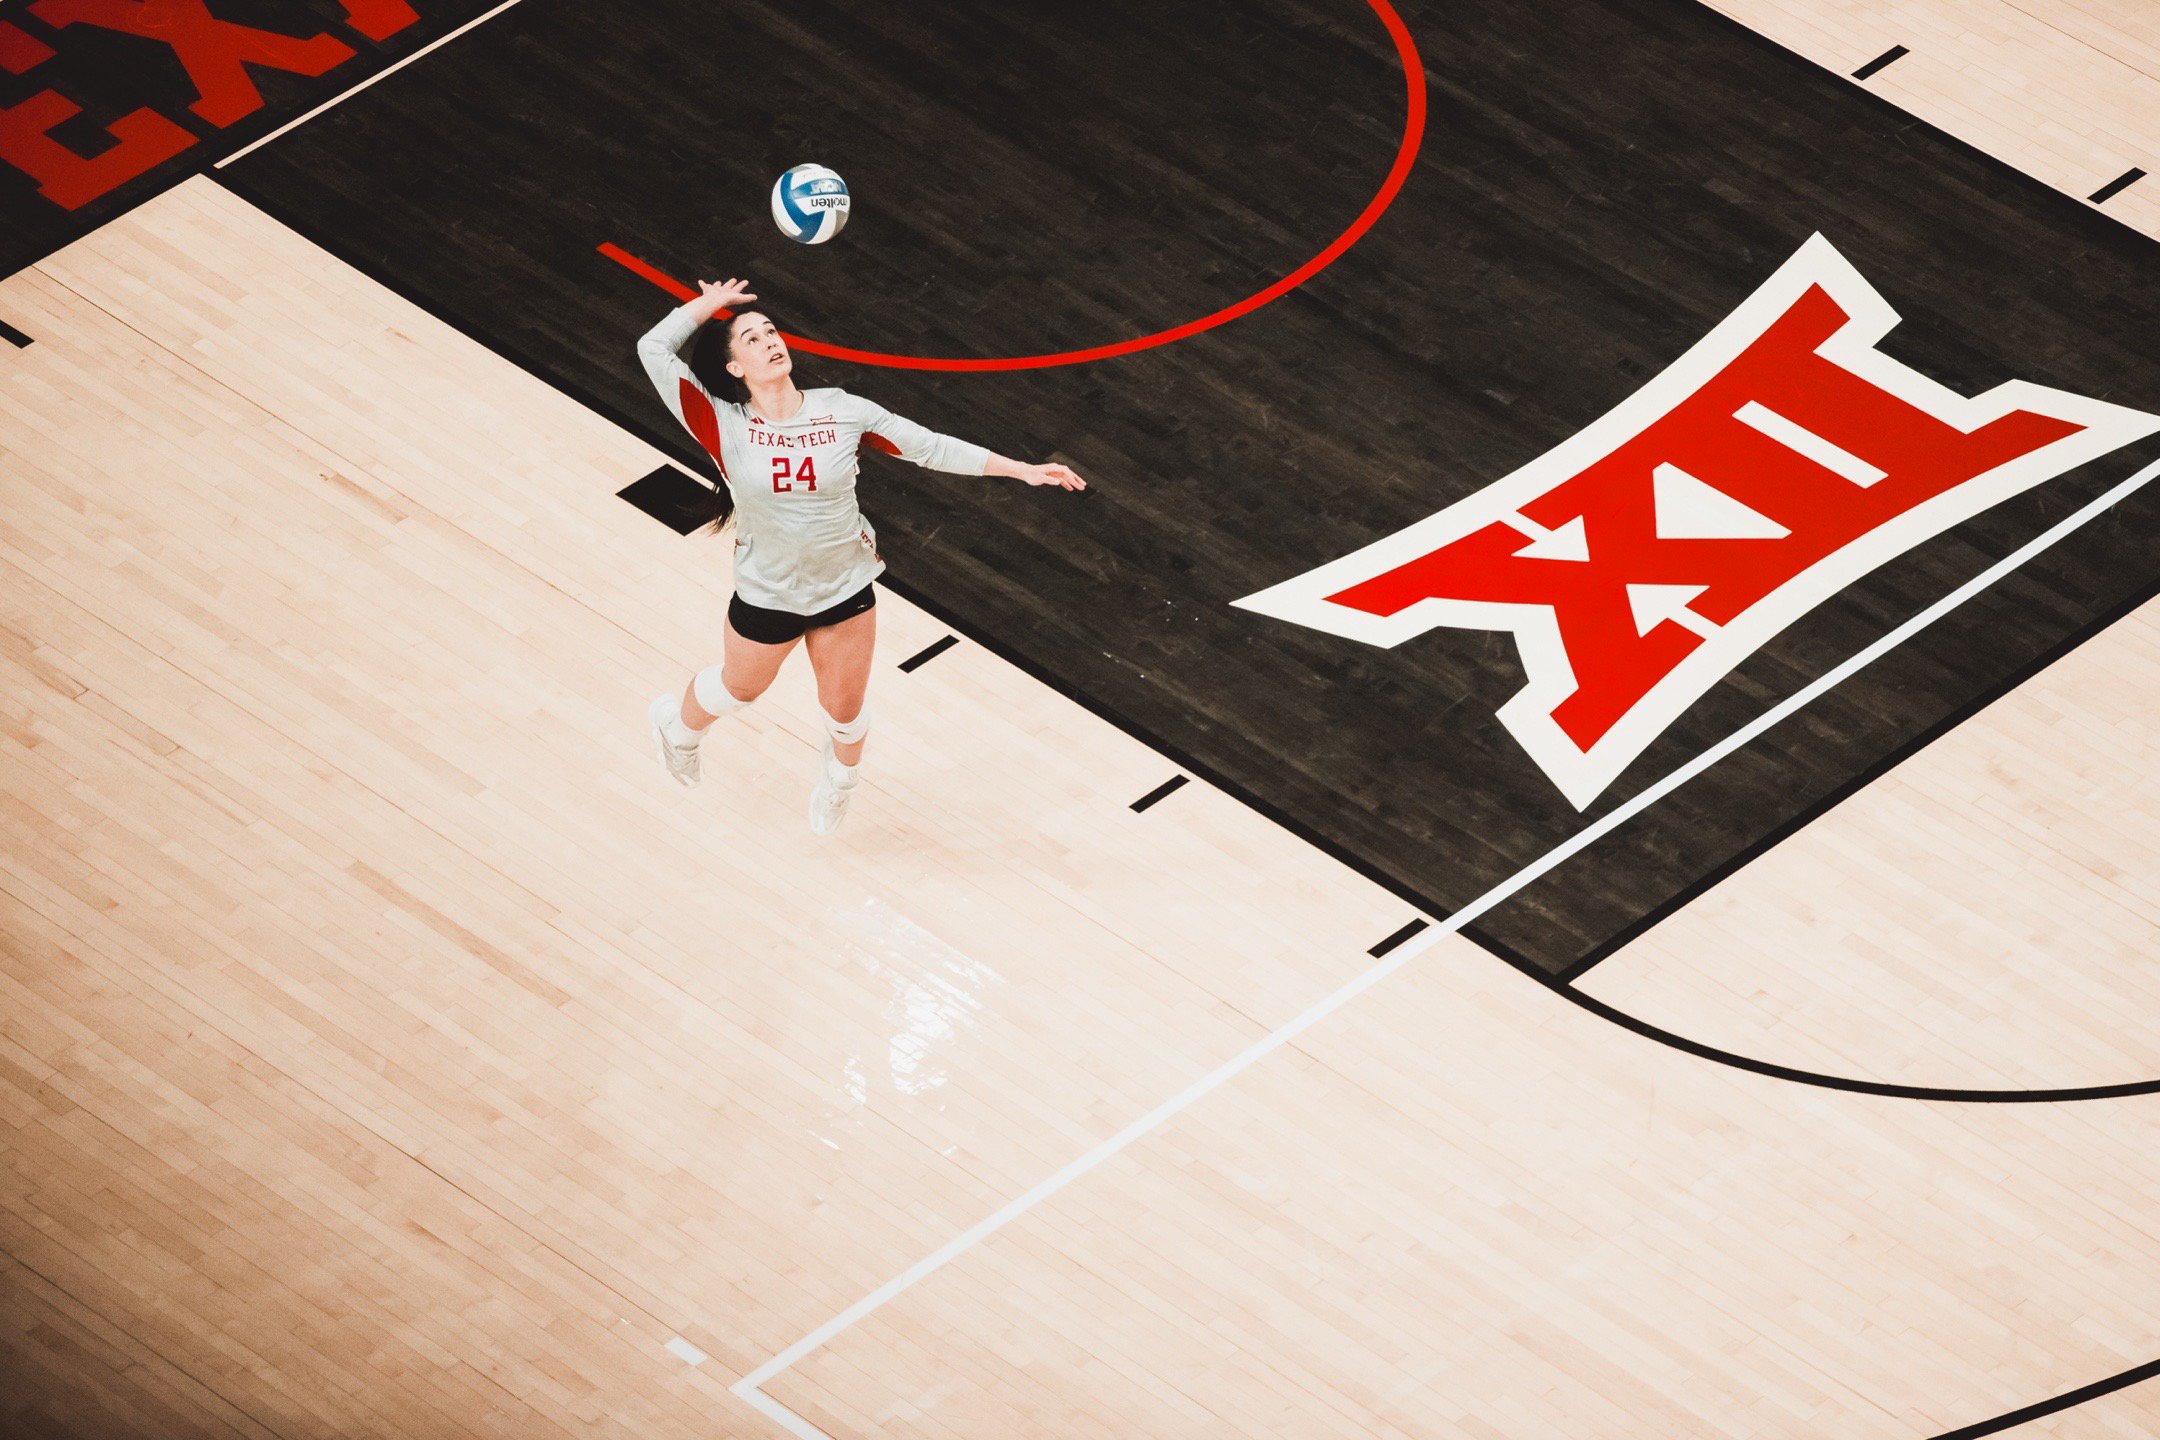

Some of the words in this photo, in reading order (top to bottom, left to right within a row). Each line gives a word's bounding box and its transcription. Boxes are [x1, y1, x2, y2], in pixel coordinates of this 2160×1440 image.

[0, 0, 421, 212] EX
[811, 198, 847, 208] molten
[797, 429, 836, 449] TECH
[771, 456, 817, 493] 24
